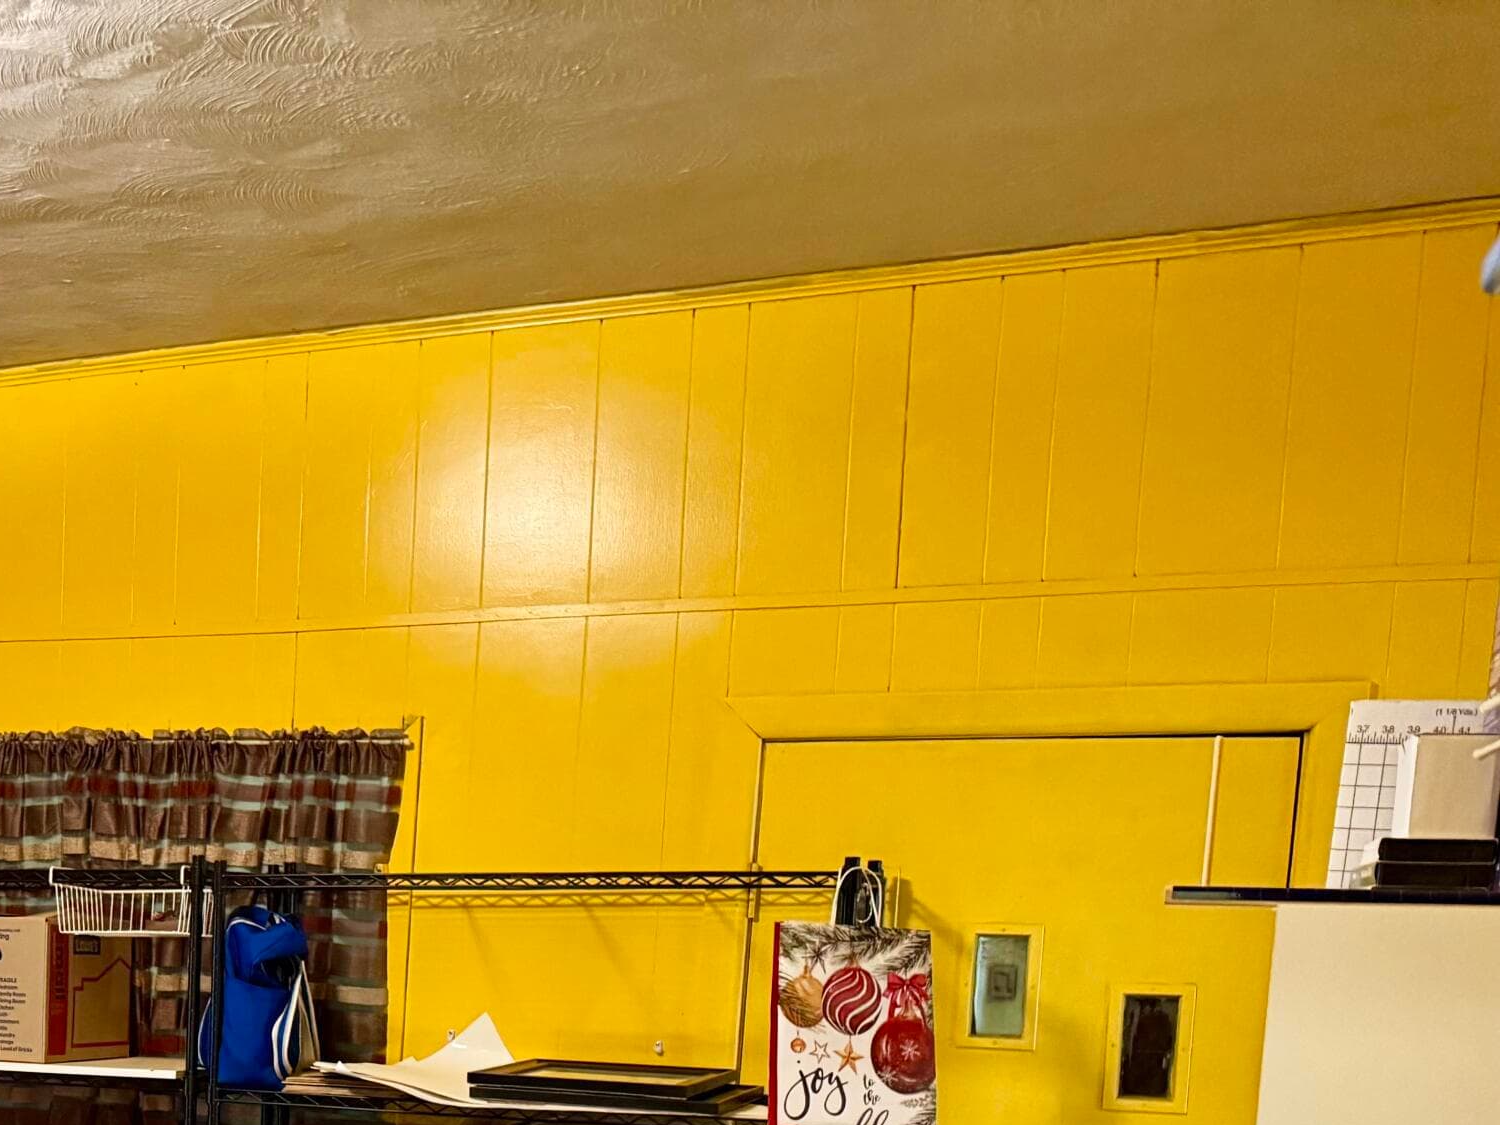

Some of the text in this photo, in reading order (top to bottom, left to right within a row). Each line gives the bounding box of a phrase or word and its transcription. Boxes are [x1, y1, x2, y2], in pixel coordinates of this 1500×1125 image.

[1357, 725, 1370, 733] 37
[1382, 725, 1395, 734] 38
[1407, 725, 1421, 734] 39
[863, 1073, 876, 1089] to
[784, 1060, 849, 1120] joy
[863, 1089, 881, 1106] the
